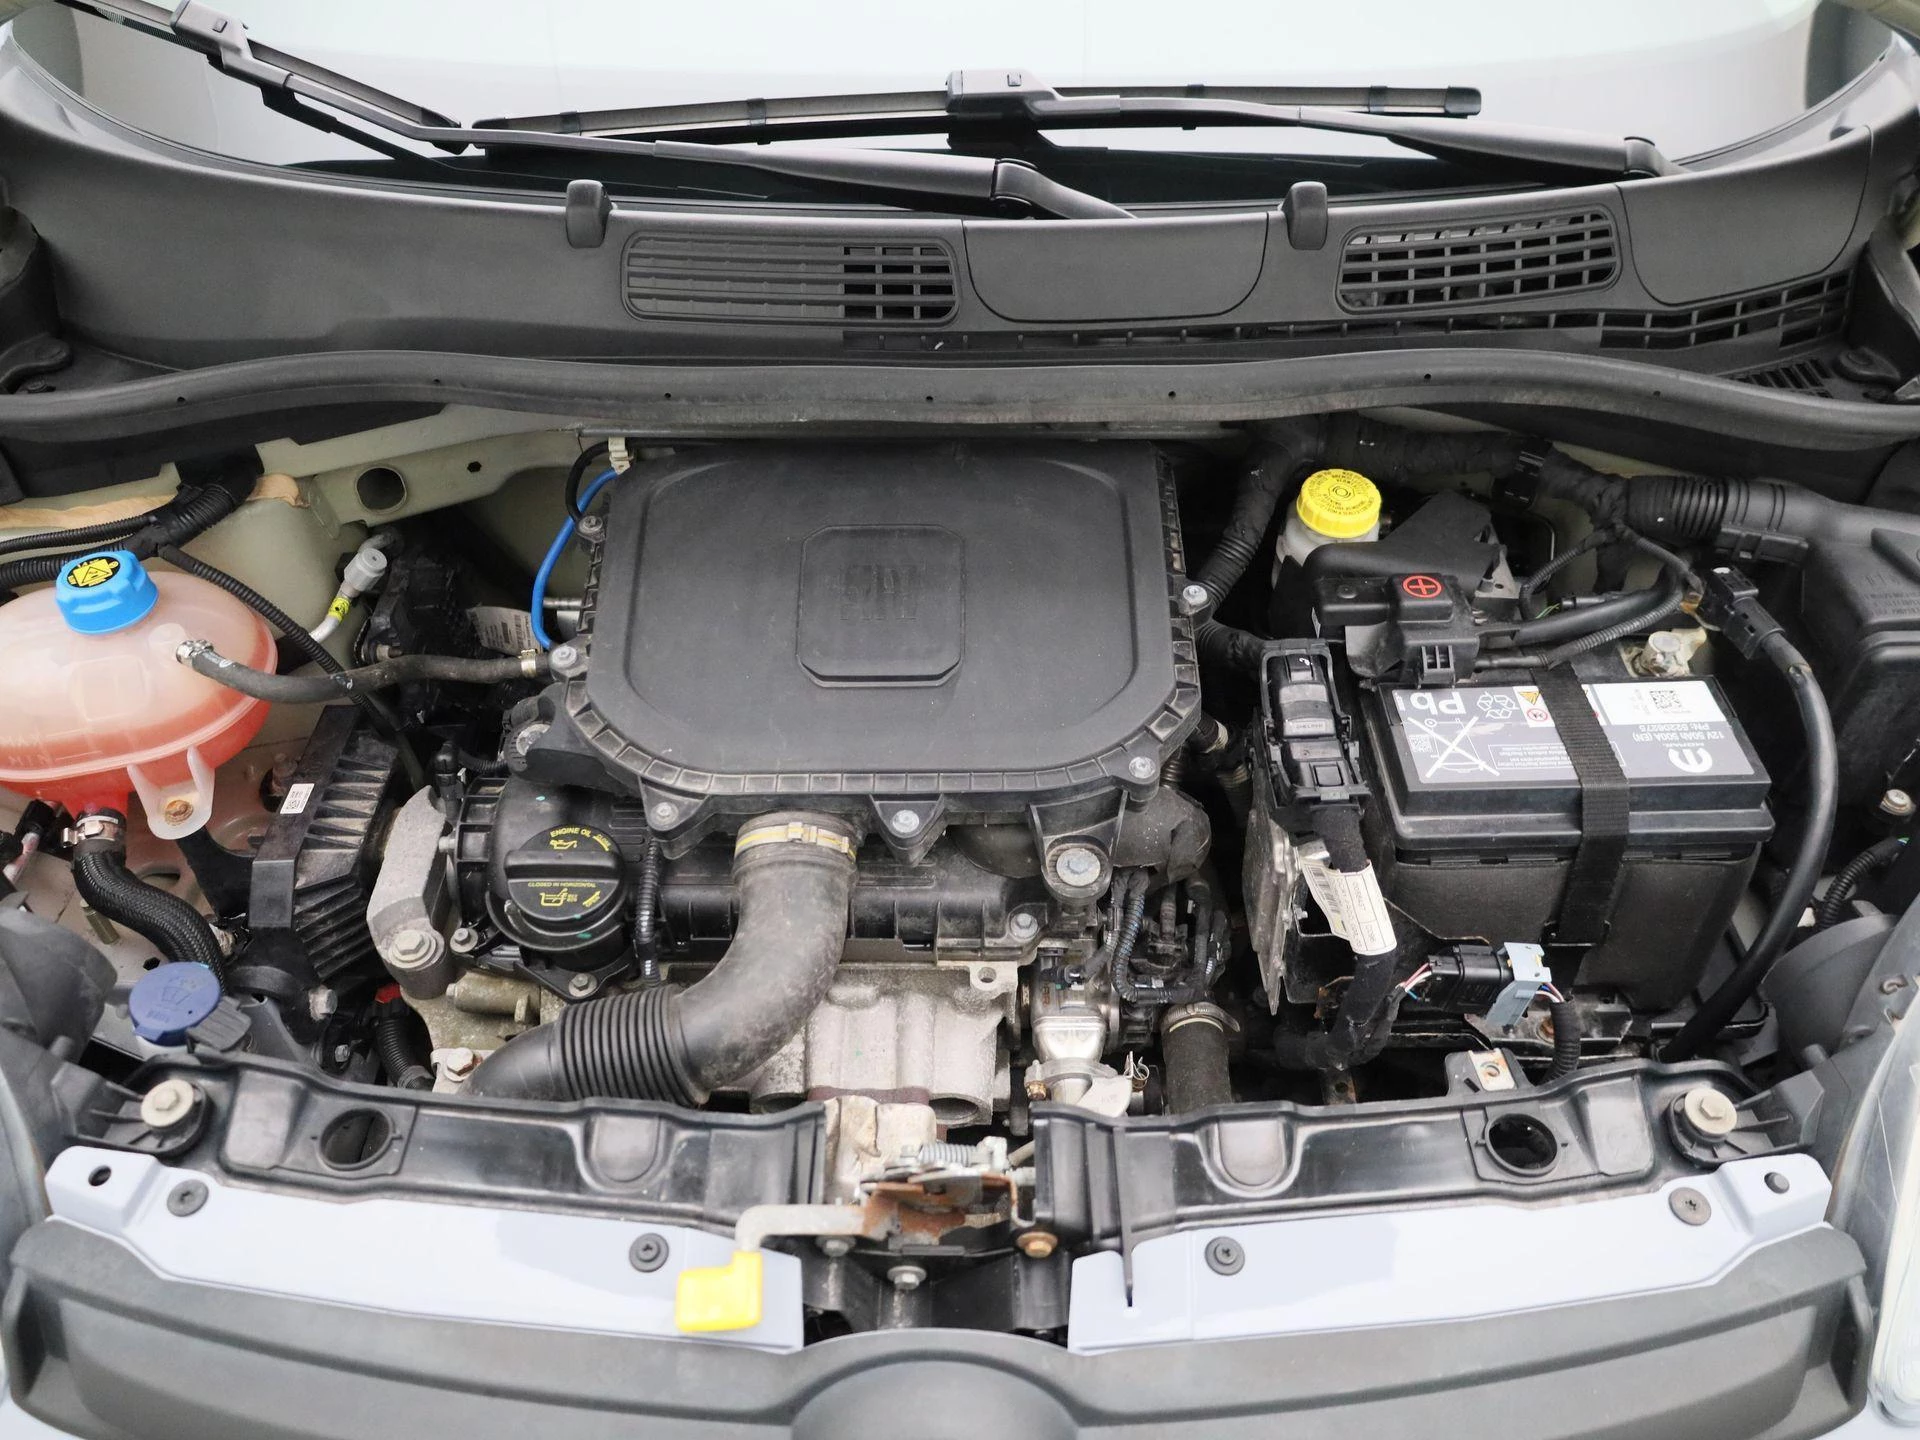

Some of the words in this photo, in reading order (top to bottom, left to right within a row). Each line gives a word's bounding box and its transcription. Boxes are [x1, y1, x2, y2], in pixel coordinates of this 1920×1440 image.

[1410, 691, 1467, 715] Pb
[1653, 731, 1680, 741] 500A
[1680, 731, 1706, 741] 50Ah
[1707, 730, 1725, 740] 12V
[550, 827, 580, 838] ENGINE
[581, 828, 592, 838] OIL
